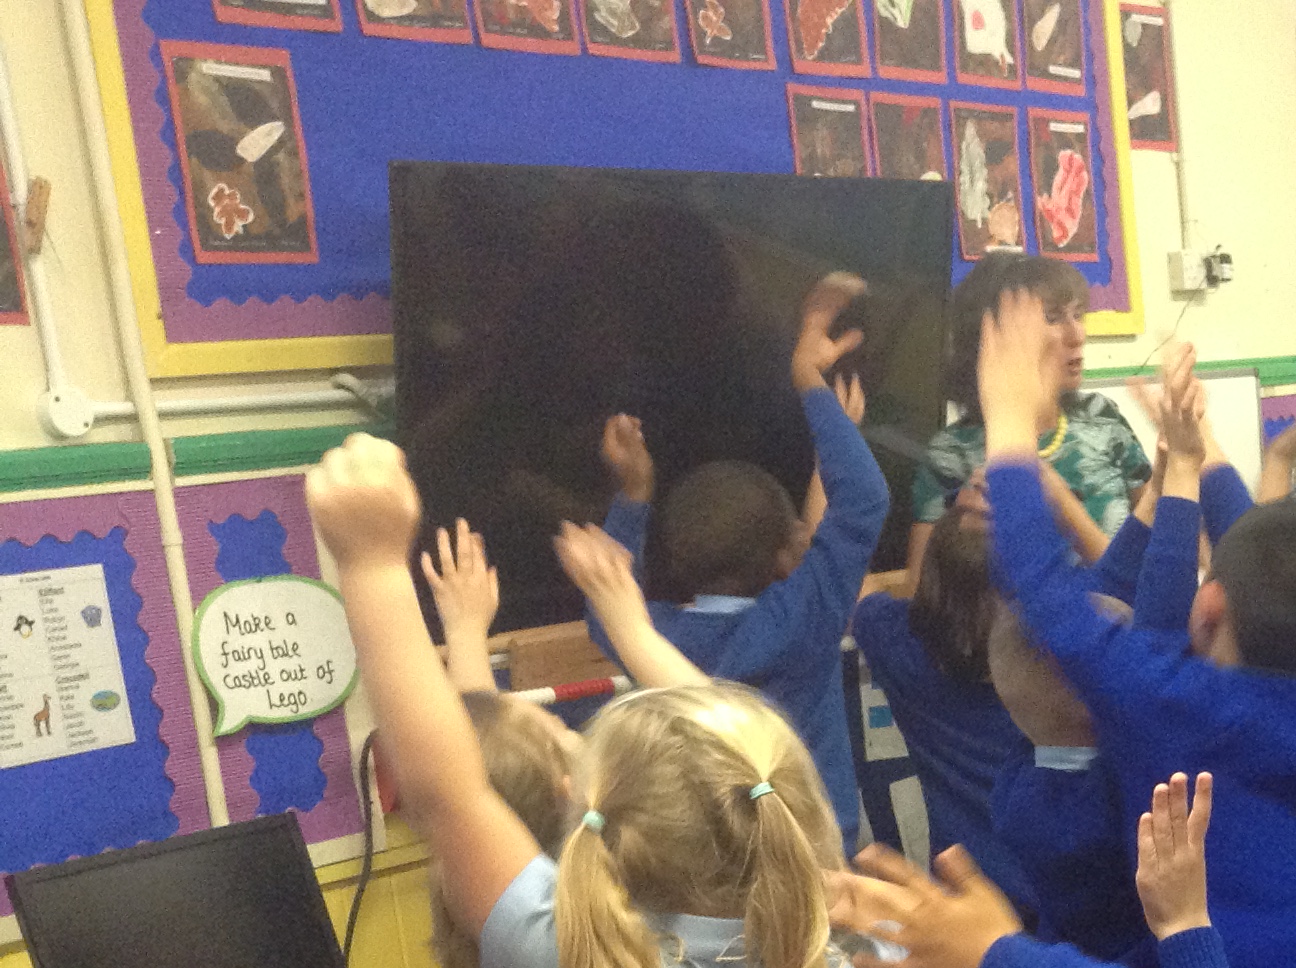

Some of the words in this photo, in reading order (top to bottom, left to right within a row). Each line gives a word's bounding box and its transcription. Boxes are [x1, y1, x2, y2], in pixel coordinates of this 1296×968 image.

[223, 610, 276, 636] Make
[285, 611, 298, 627] a
[221, 640, 266, 671] fairy
[268, 639, 301, 660] tale
[279, 664, 307, 682] out
[316, 659, 336, 684] of
